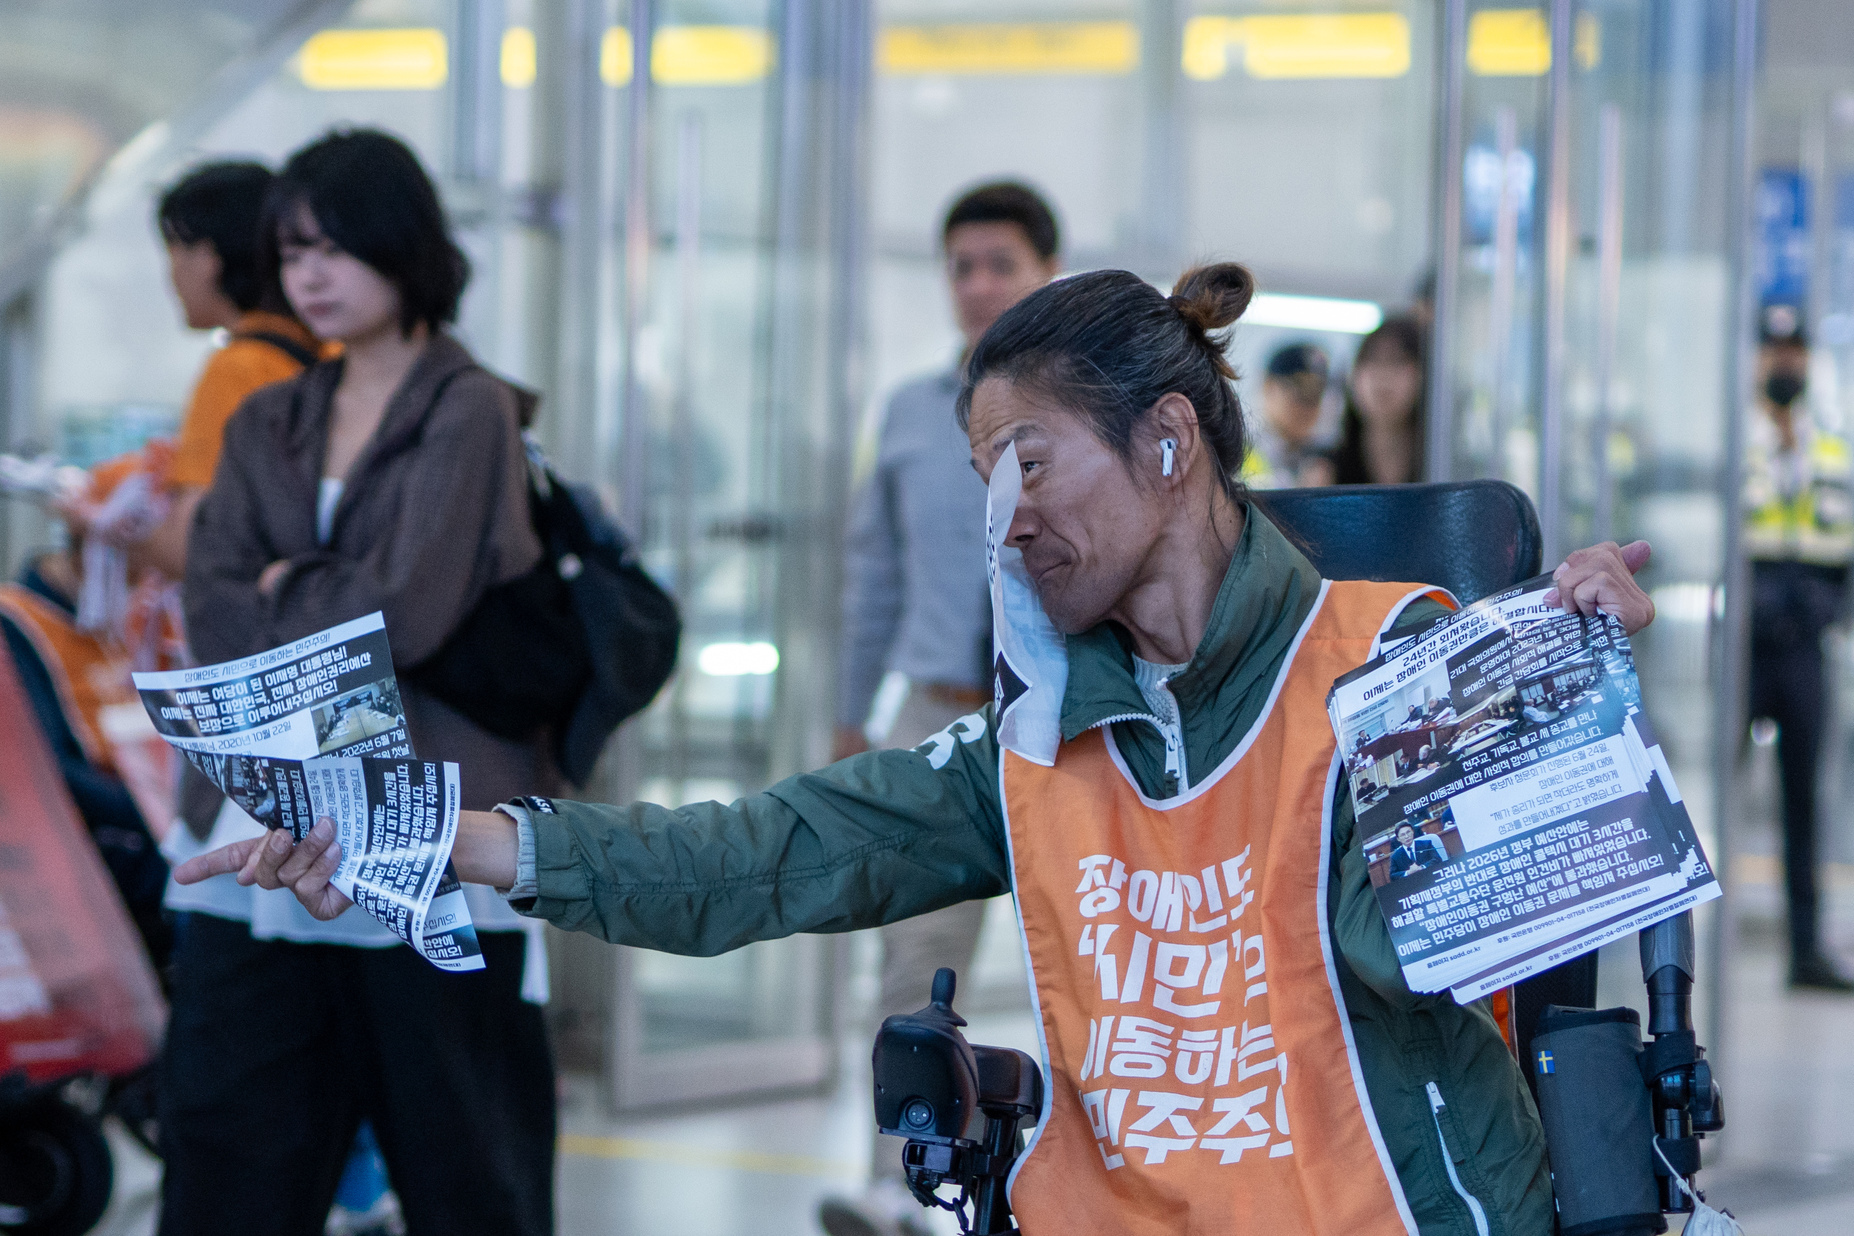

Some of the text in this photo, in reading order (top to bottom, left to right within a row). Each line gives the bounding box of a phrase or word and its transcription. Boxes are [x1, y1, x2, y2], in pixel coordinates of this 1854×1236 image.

[1385, 638, 1416, 662] 장애인도
[1418, 619, 1449, 642] 시민으로
[1486, 588, 1523, 606] 민주주의!
[1403, 640, 1436, 666] 24년간
[1480, 650, 1511, 674] 운영하며
[1512, 634, 1542, 654] 2023년
[1544, 629, 1557, 638] 1월
[1559, 623, 1580, 634] 30일
[161, 652, 371, 720] 이제는 진짜 대한민국, 진짜 장애인권리예산
[176, 646, 347, 706] 이제는 여당이 된 이재명 대통령님!
[184, 633, 331, 682] 장애인도 시민으로 이동하는 민주주의!
[1363, 680, 1394, 701] 이제는
[1396, 661, 1426, 683] 장애인
[1429, 622, 1489, 663] 이동권만큼은
[1450, 635, 1512, 679] 21대 국회의원에서
[1462, 677, 1486, 698] 장애인
[1487, 662, 1511, 682] 이동권
[1512, 650, 1536, 668] 사회적
[1537, 636, 1563, 654] 해결을
[1564, 629, 1581, 641] 위한
[1496, 674, 1514, 690] 긴급
[1514, 657, 1548, 680] 간담회를
[1549, 640, 1583, 663] 시작으로
[198, 714, 245, 733] 보장으로
[248, 682, 338, 722] 이루어내주십시오!
[218, 735, 251, 750] 2020년
[252, 729, 271, 742] 10월
[272, 721, 292, 736] 22일
[342, 739, 374, 757] 2022년
[374, 734, 390, 748] 6월
[390, 728, 406, 742] 7일
[1462, 709, 1598, 772] 천주교, 기독교, 불교 세 종교를 만나
[383, 772, 398, 806] 3시간을
[395, 763, 410, 834] 빠져있었습니다.
[423, 763, 438, 804] 주십시오!
[1403, 725, 1604, 815] 장애인 이동권에 대한 사회적 합의를 만들어갔습니다.
[1490, 777, 1514, 792] 후보자
[1514, 766, 1546, 784] 청문회가
[1547, 755, 1572, 771] 진행된
[1572, 750, 1587, 762] 6월
[1511, 799, 1536, 816] 총리가
[1537, 794, 1553, 806] 되면
[1553, 781, 1586, 799] 작더라도
[1586, 769, 1620, 788] 명확하게
[1539, 755, 1615, 790] 장애인 이동권에 대해
[385, 808, 398, 830] 대기
[408, 784, 424, 849] 불과했습니다.
[423, 807, 438, 839] 책임져
[1498, 819, 1523, 835] 성과를
[1582, 783, 1625, 804] 밝혔습니다.
[361, 804, 385, 879] 예산안에는 정부
[1398, 817, 1634, 910] 기획재정부의 반대로 장애인 콜택시 대기 3시간을
[1432, 820, 1590, 883] 그러나 2026년 정부 예산안에는
[1075, 844, 1255, 933] 장애인도
[1391, 907, 1425, 928] 해결할
[1426, 884, 1491, 915] 특별교통수단
[1492, 871, 1526, 893] 운전원
[1526, 855, 1571, 880] 인건비가
[1572, 828, 1651, 864] 빠져있었습니다.
[1398, 938, 1432, 956] 이제는
[1432, 920, 1477, 945] 민주당이
[1477, 907, 1512, 928] 장애인
[1512, 895, 1546, 916] 이동권
[1547, 883, 1581, 904] 문제를
[1581, 871, 1615, 890] 책임져
[1616, 853, 1664, 879] 주십시오!
[1492, 887, 1524, 908] 구멍난
[1564, 850, 1633, 883] 불과했습니다.
[1080, 1014, 1278, 1088] 이동하는
